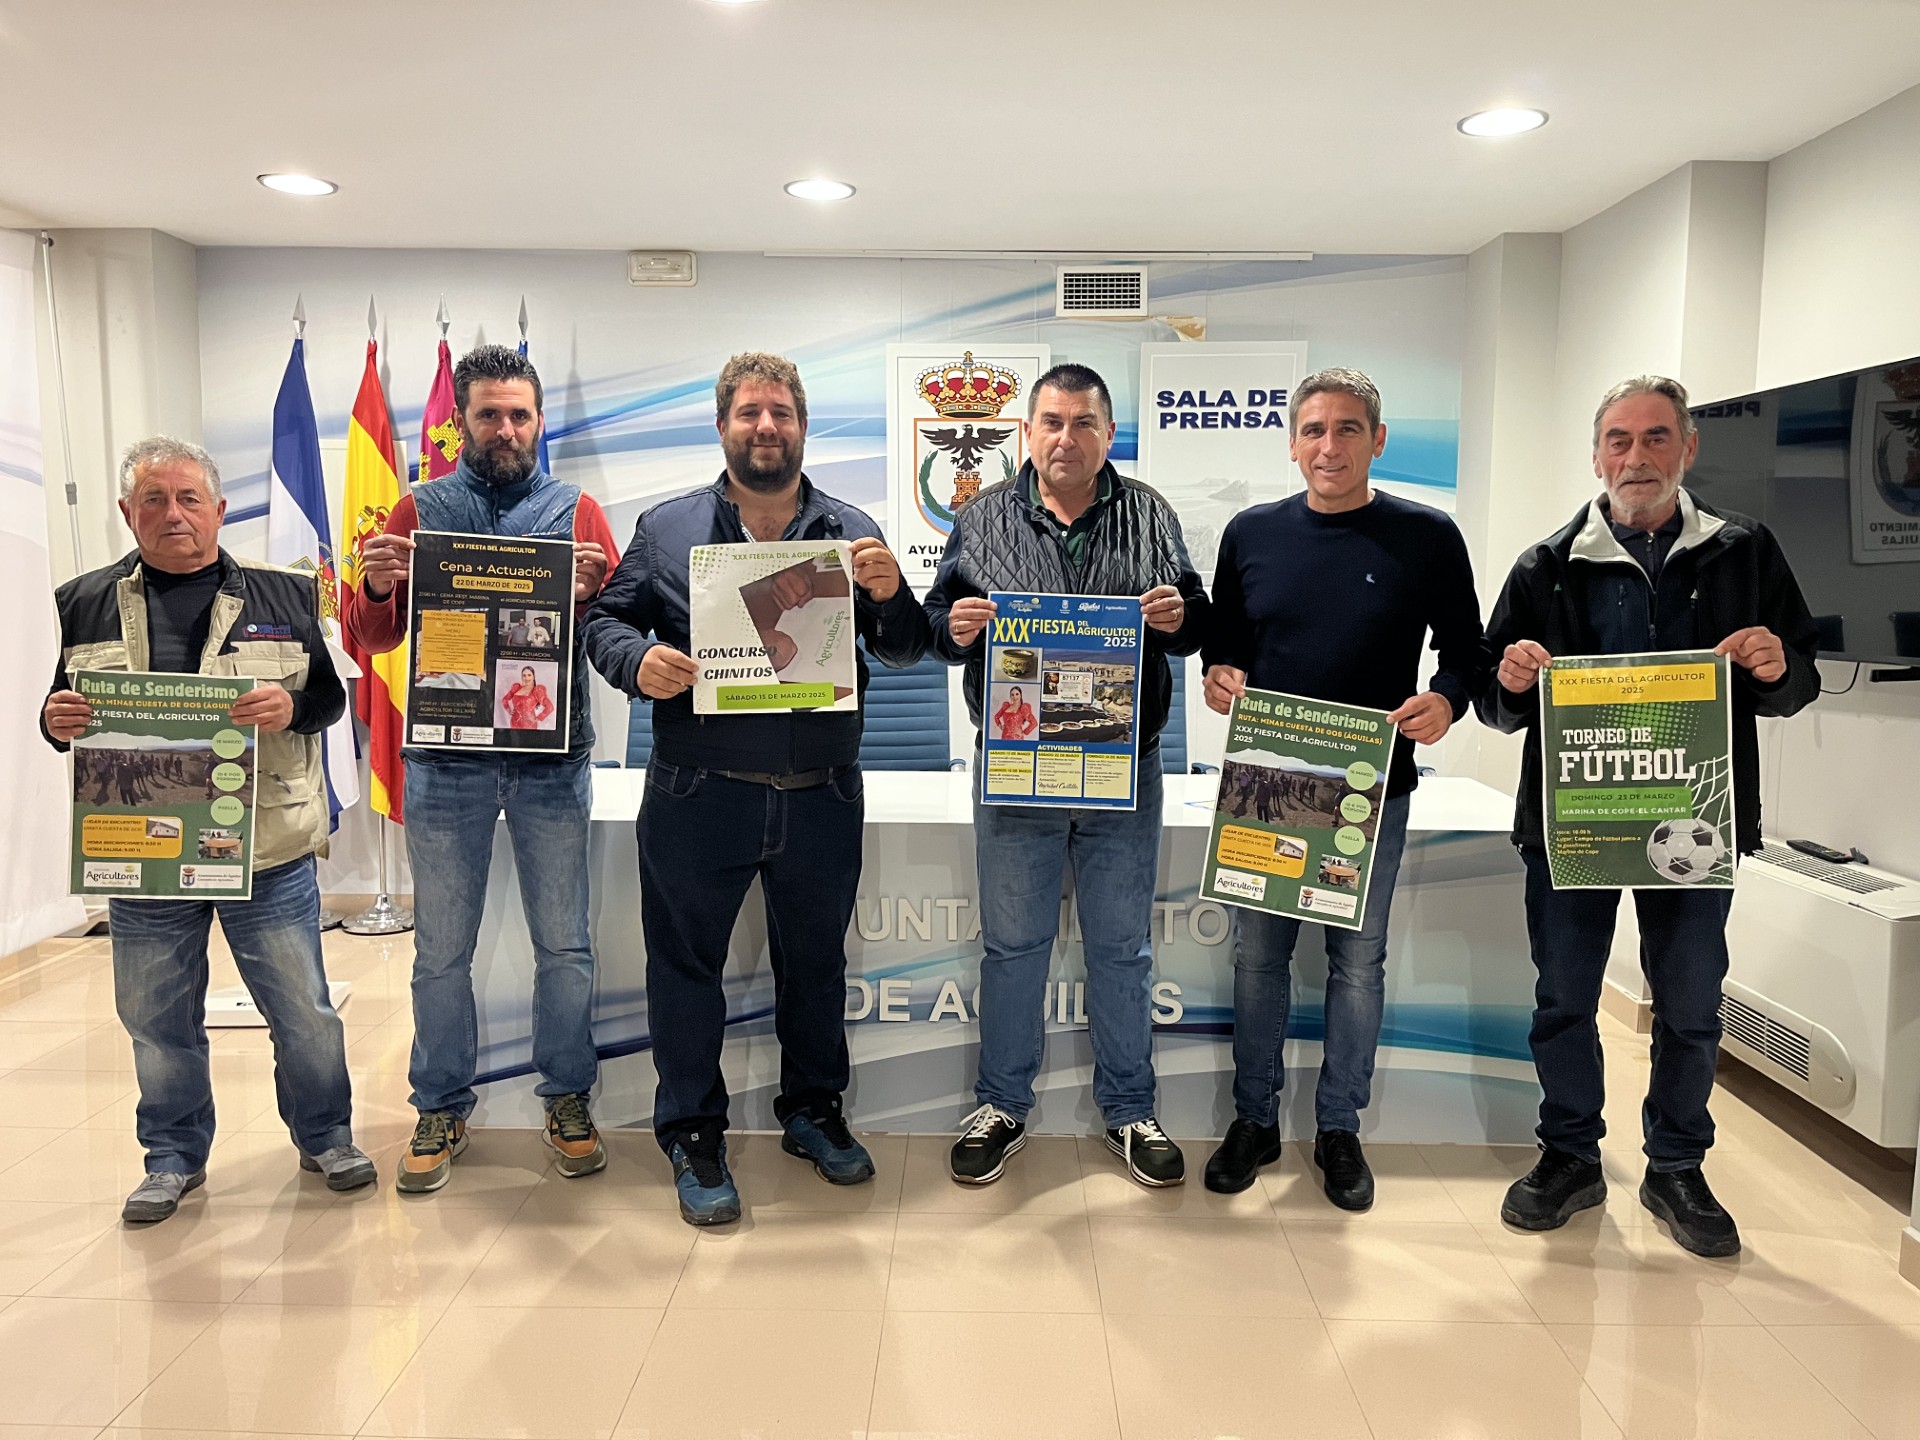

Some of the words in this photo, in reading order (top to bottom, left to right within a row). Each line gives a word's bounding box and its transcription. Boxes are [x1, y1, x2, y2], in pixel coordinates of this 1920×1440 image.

[1157, 390, 1235, 408] SALA
[1248, 389, 1288, 407] DE
[1159, 411, 1284, 430] PRENSA
[466, 543, 487, 551] FIESTA
[499, 546, 537, 554] AGRICULTOR
[440, 561, 473, 573] Cena
[486, 564, 552, 578] Actuación
[476, 580, 500, 588] MARZO
[992, 617, 1031, 643] XXX
[1031, 619, 1076, 635] FIESTA
[1076, 627, 1136, 637] AGRICULTOR
[815, 610, 845, 668] Agricultores
[1103, 637, 1137, 647] 2025
[697, 646, 778, 660] CONCURSO
[704, 666, 773, 680] CHINITOS
[1581, 677, 1615, 685] FIESTA
[1617, 676, 1638, 684] DEL
[1639, 673, 1706, 683] AGRICULTOR
[81, 678, 116, 695] Ruta
[120, 681, 141, 697] de
[144, 681, 239, 700] Senderismo
[106, 699, 134, 707] MINAS
[183, 701, 201, 709] GOS
[725, 693, 757, 701] SÁBADO
[101, 710, 135, 719] FIESTA
[136, 712, 155, 720] DEL
[157, 713, 220, 722] AGRICULTOR
[1239, 696, 1271, 714] Ruta
[1274, 702, 1292, 718] de
[1295, 705, 1379, 733] Senderismo
[1237, 713, 1259, 723] RUTA:
[1260, 717, 1285, 728] MINAS
[1285, 721, 1314, 733] CUESTA
[1315, 726, 1325, 734] DE
[1326, 728, 1343, 738] GOS
[1343, 731, 1383, 746] (ÁGUILAS)
[1562, 728, 1626, 745] TORNEO
[1629, 726, 1652, 743] DE
[1233, 733, 1254, 744] 2025
[1235, 724, 1253, 734] XXX
[1253, 727, 1284, 739] FIESTA
[1284, 733, 1301, 743] DEL
[1301, 736, 1358, 753] AGRICULTOR
[1037, 744, 1083, 752] ACTIVIDADES
[1558, 744, 1697, 783] FÚTBOL
[1561, 808, 1596, 816] MARINA
[1611, 807, 1649, 815] COPE-EL
[86, 870, 140, 882] Agricultores
[1216, 877, 1264, 894] Agricultores
[843, 978, 912, 1023] DE
